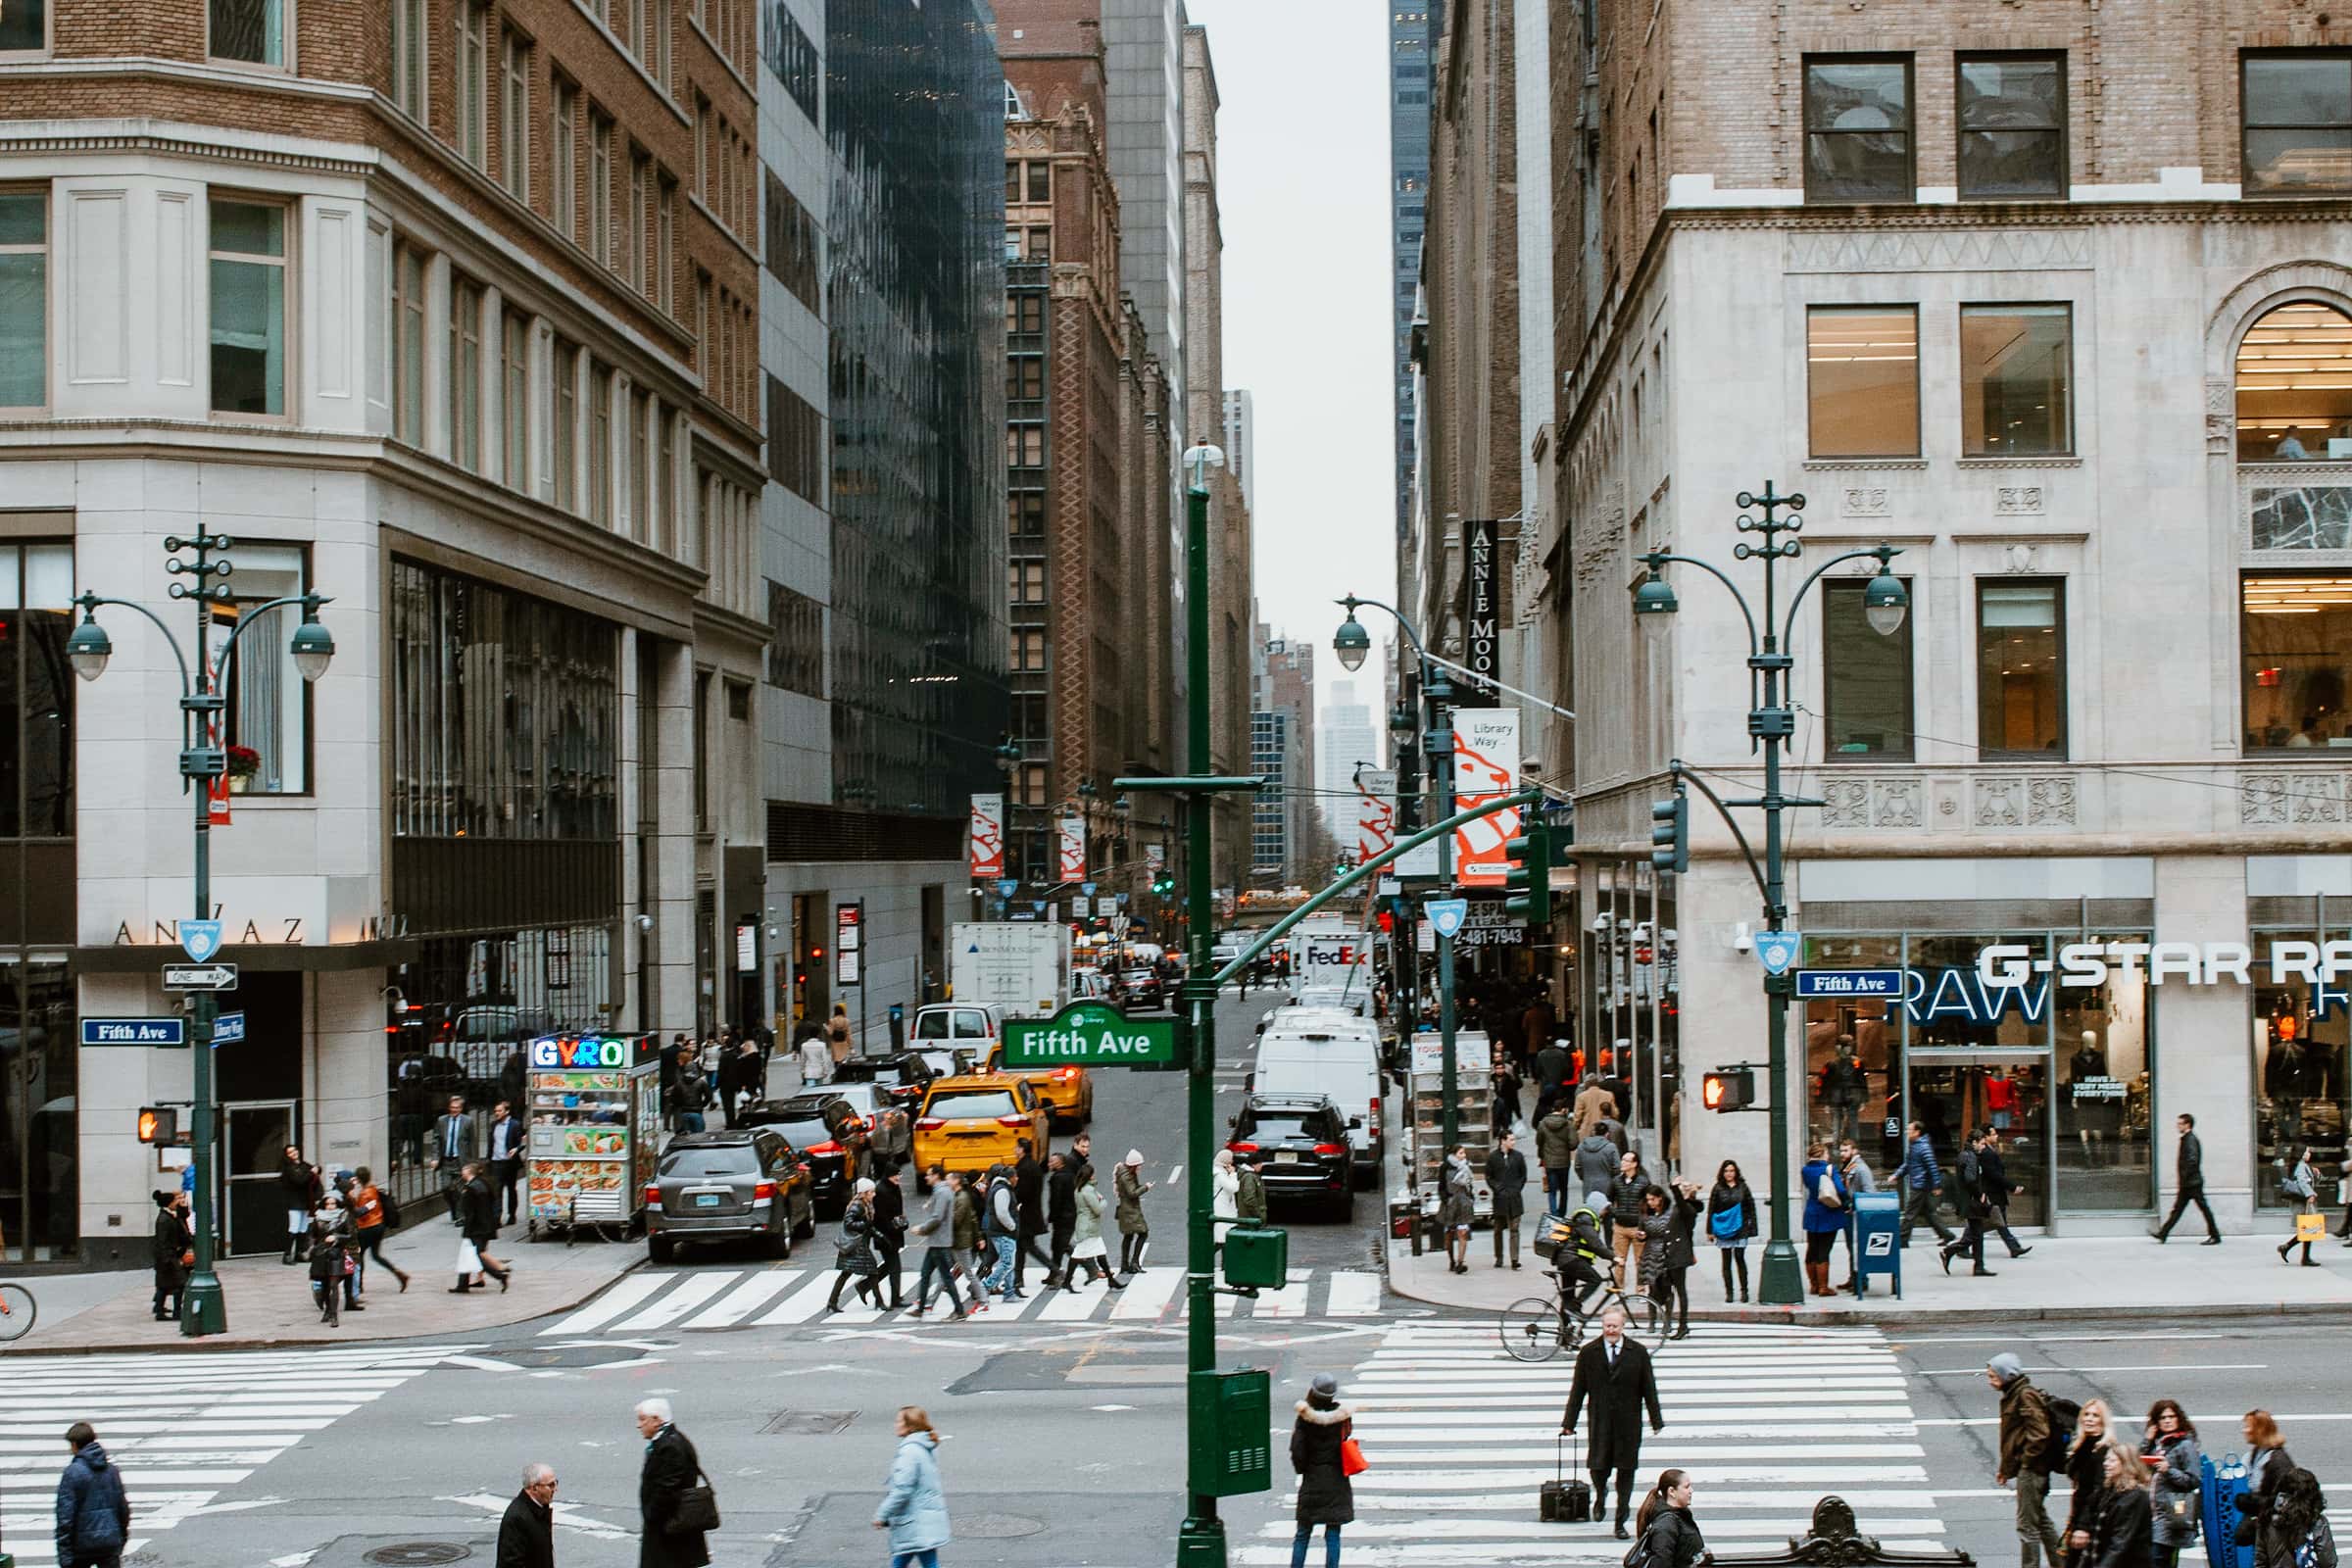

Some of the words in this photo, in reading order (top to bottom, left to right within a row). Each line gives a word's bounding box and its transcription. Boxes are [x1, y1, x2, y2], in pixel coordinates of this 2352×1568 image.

[1472, 527, 1492, 612] ANNIE
[1474, 723, 1514, 736] Library
[1474, 736, 1498, 749] Way
[1307, 946, 1368, 965] FedEx
[1980, 942, 2251, 988] G-STAR
[172, 972, 193, 981] ONE
[207, 972, 226, 981] WAY
[1813, 976, 1852, 992] Fifth
[1855, 976, 1886, 991] Ave
[98, 1025, 135, 1040] Fifth
[137, 1025, 167, 1040] Ave
[1023, 1030, 1088, 1056] Fifth
[1097, 1030, 1152, 1054] Ave
[534, 1040, 624, 1066] GYRO
